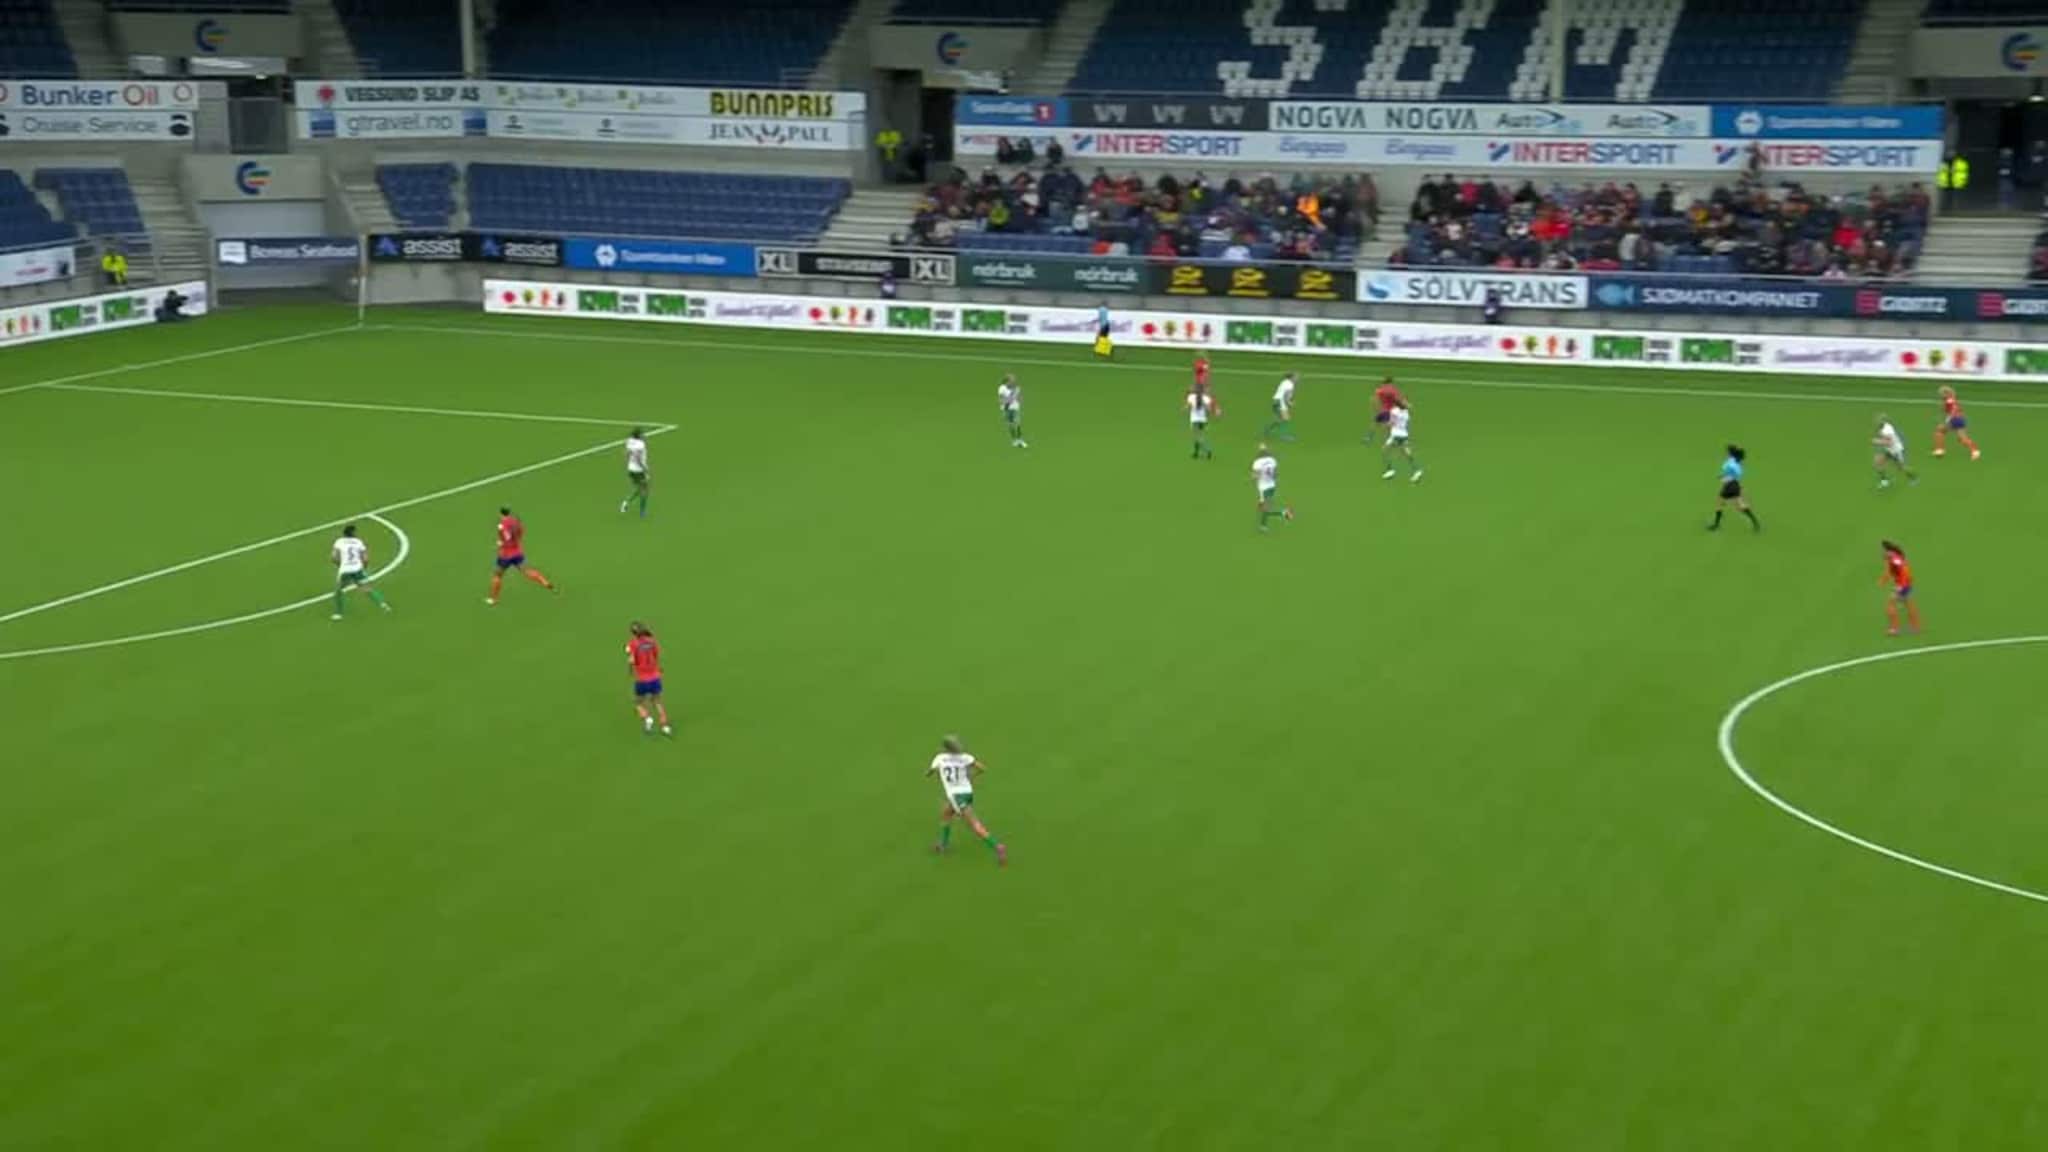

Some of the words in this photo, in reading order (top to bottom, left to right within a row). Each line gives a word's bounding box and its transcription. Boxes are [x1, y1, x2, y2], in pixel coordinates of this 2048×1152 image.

[22, 84, 118, 106] Bunker
[123, 83, 159, 106] Oil
[1277, 106, 1366, 128] NOGVA
[1386, 108, 1477, 129] NOGVA
[1096, 134, 1242, 156] INTERSPORT
[1513, 142, 1678, 165] INTERSPORT
[1756, 145, 1921, 168] NTERSPORT
[761, 252, 793, 272] XL
[917, 259, 949, 281] XL
[943, 766, 962, 783] 21
